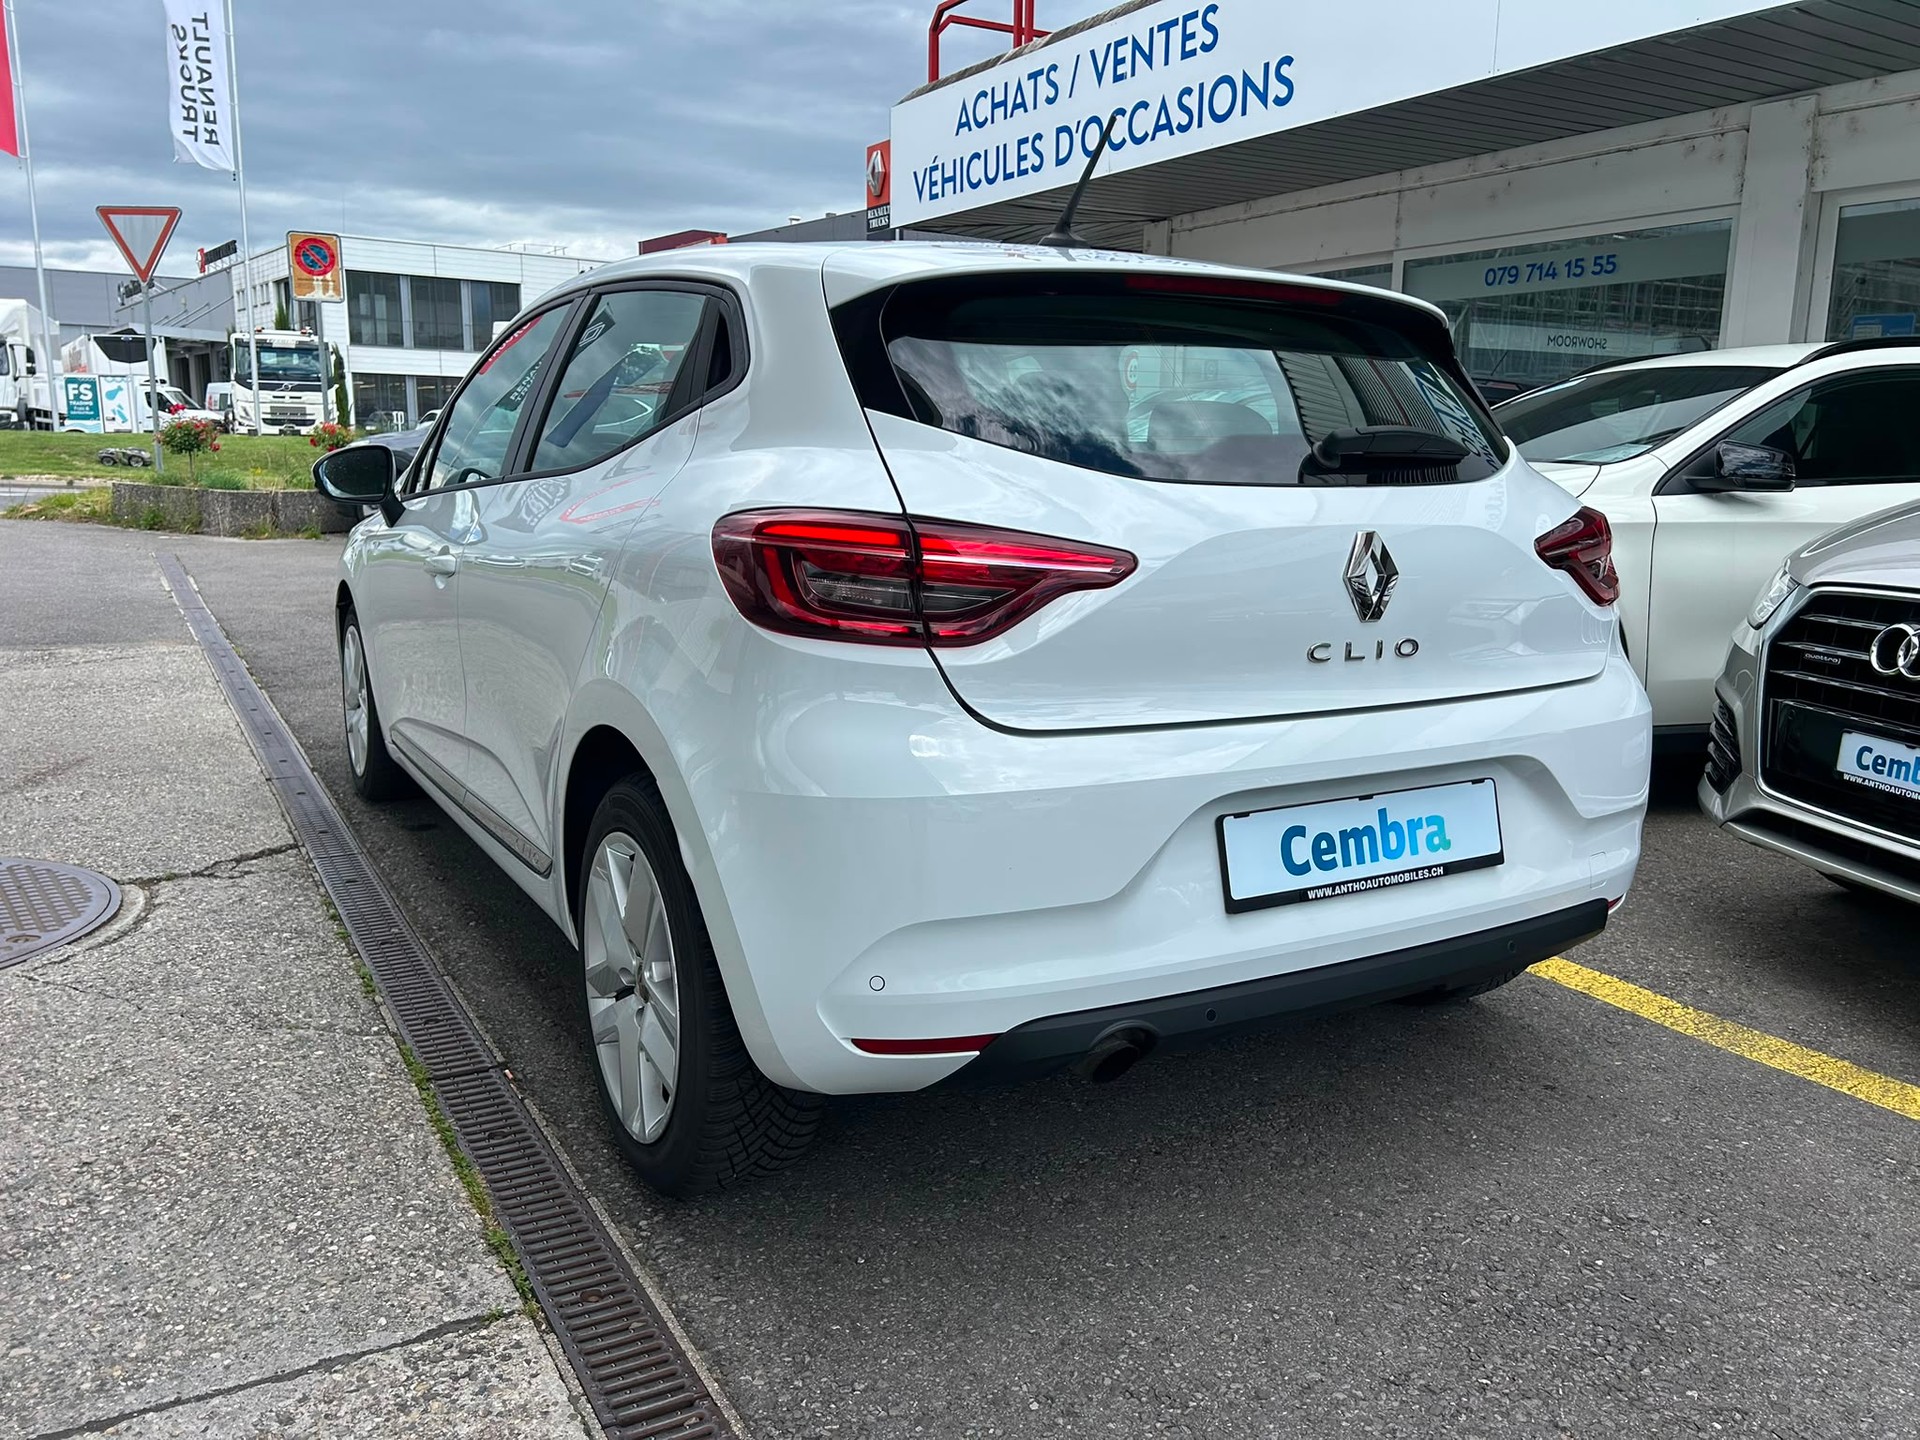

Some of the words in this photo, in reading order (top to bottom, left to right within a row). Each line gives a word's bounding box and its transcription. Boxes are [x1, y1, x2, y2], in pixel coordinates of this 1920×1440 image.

[955, 63, 1059, 136] ACHATS
[1068, 54, 1080, 99] /
[1089, 3, 1220, 89] VENTES
[912, 131, 1045, 204] VÉHICULES
[869, 215, 889, 229] TRUCKS
[1484, 265, 1519, 287] 079
[1525, 261, 1558, 283] 714
[1564, 257, 1585, 279] 15
[1590, 254, 1617, 276] 55
[66, 383, 93, 401] FS
[1306, 638, 1419, 663] CLIO
[1804, 653, 1839, 664] quattro
[1280, 807, 1452, 877] Cembra
[1307, 866, 1444, 900] WWW.ANTHOAUTOMOBILES.CH
